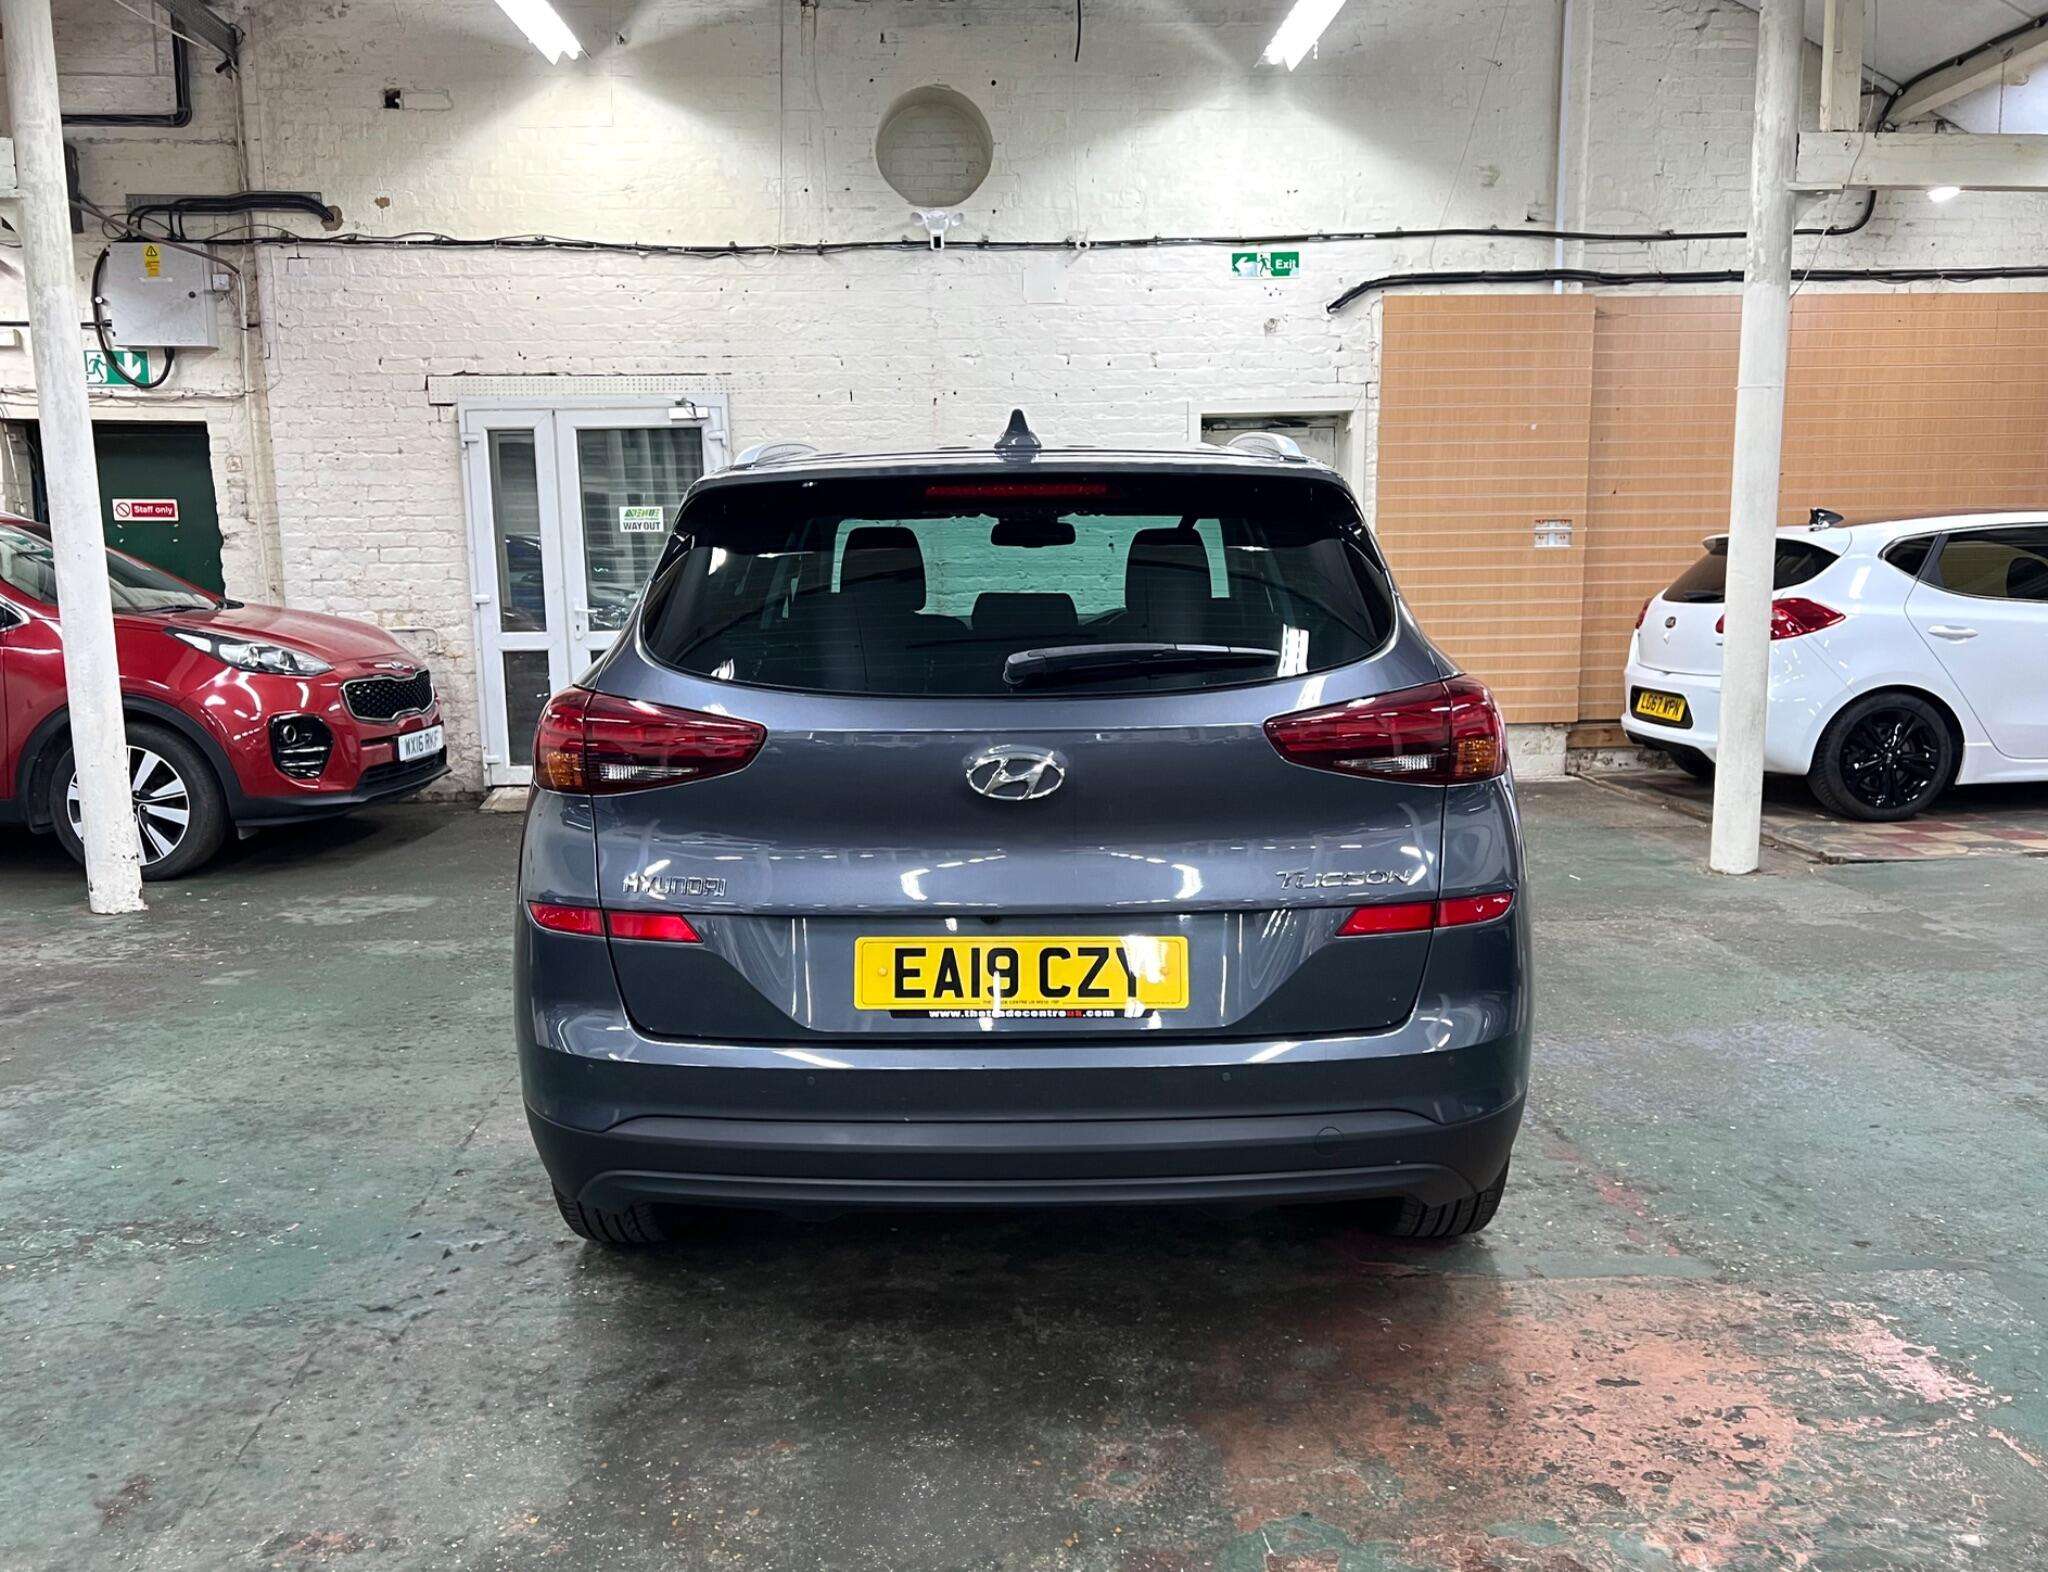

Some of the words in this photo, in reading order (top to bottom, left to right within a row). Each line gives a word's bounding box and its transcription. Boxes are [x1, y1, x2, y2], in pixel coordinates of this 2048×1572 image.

[1275, 259, 1297, 269] Exit
[133, 505, 153, 513] Staff
[155, 505, 173, 514] only
[623, 521, 642, 531] WAY
[643, 521, 661, 531] OUT
[1276, 867, 1411, 889] TUCSON
[622, 874, 727, 898] HYUNDAI
[893, 947, 1019, 999] EA19
[1038, 947, 1146, 999] CZY
[928, 1010, 1115, 1019] www.thetadecentreuk.com
